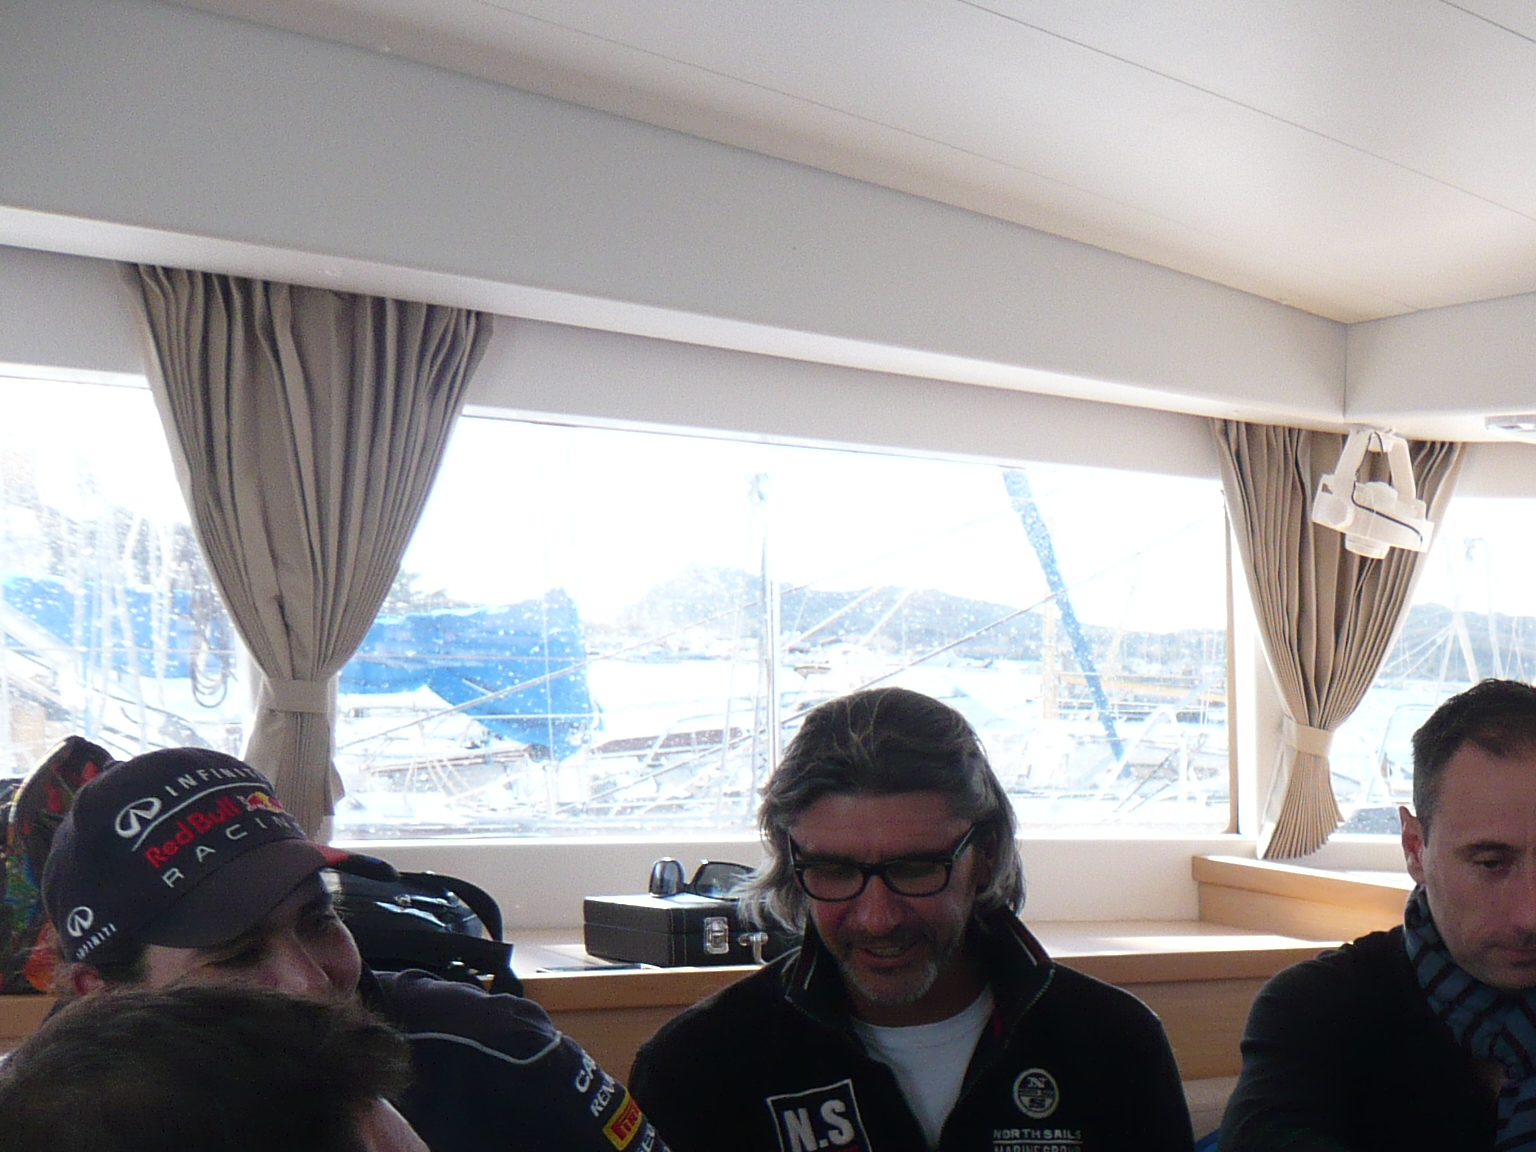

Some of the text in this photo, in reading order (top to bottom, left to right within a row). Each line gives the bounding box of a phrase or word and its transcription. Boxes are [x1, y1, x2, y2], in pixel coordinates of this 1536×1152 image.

[145, 796, 242, 869] Red Bull
[161, 815, 307, 888] RACIN
[992, 1128, 1041, 1140] NORTH
